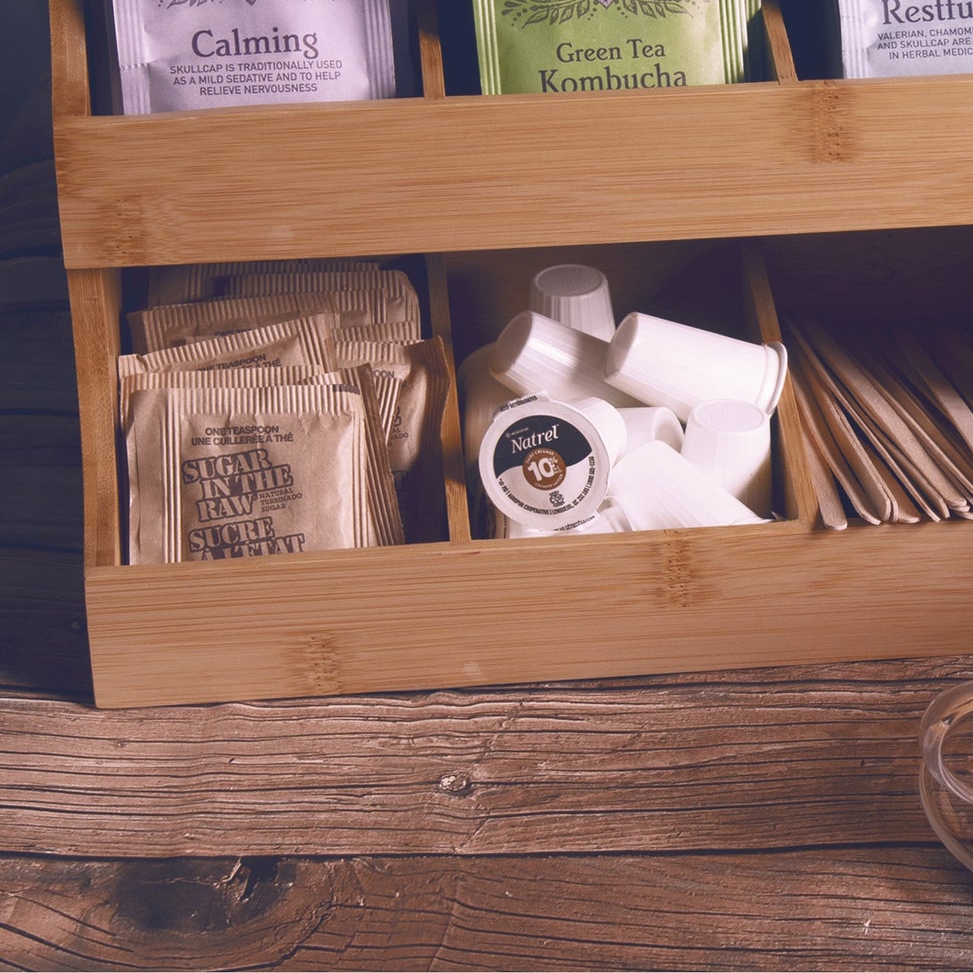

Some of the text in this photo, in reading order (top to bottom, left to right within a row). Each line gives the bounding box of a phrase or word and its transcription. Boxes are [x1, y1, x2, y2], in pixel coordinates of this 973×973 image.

[191, 27, 319, 60] Calming
[876, 41, 897, 51] AND
[899, 38, 950, 49] SKULLCAP
[952, 36, 971, 46] ARE
[877, 29, 928, 41] VALERIAN,
[556, 38, 666, 63] Green Tea
[888, 51, 900, 60] IN
[902, 48, 941, 59] HERBAL
[169, 59, 343, 75] SKULLCAP IS TRADITIONALLY USED
[173, 71, 341, 86] AS A MILD SEDATIVE AND TO HELP
[538, 63, 689, 93] Kombucha
[200, 83, 318, 96] RELIEVE NERVOUSNESS
[216, 353, 266, 370] TEASPOON
[191, 431, 294, 446] UNE CUILLERÉE À THÉ
[205, 425, 279, 436] ONE TEASPOON
[511, 424, 559, 454] Natrel
[181, 448, 273, 484] SUGAR
[200, 463, 294, 499] IN THE
[196, 493, 254, 522] RAW
[188, 516, 276, 553] SUCRE
